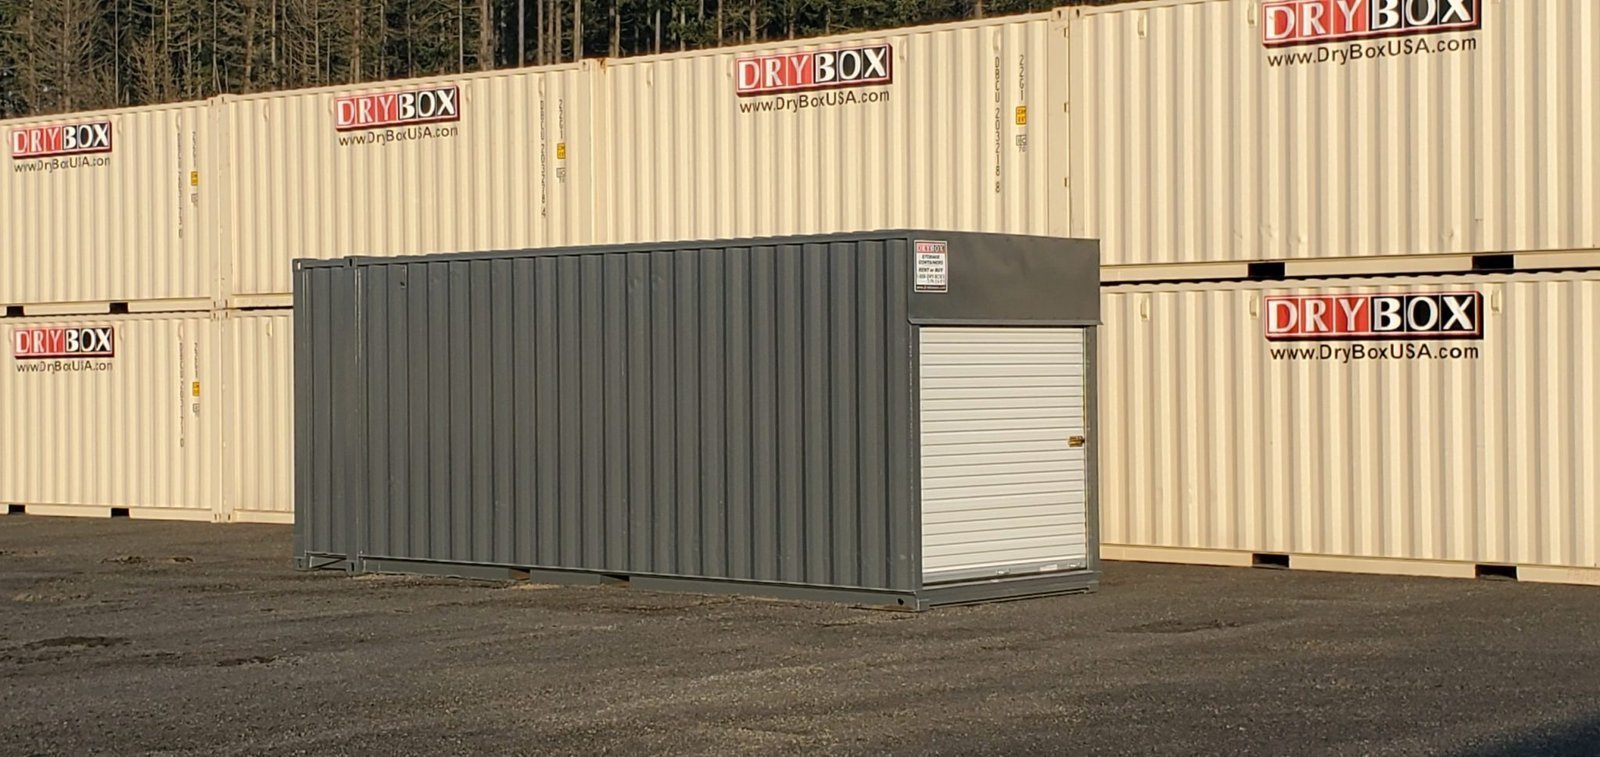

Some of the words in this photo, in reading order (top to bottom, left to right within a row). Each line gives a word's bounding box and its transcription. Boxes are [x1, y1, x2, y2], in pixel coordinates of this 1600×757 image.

[1267, 37, 1477, 67] www.DryBoxUSA.com
[738, 47, 886, 89] DRYBOX
[337, 89, 455, 125] DRYBOX
[740, 90, 890, 113] www.DryBoxUSA.com
[13, 124, 109, 153] DRYBOX
[1267, 294, 1474, 334] DRYBOX
[16, 328, 112, 354] DRYBOX
[1269, 343, 1479, 364] www.DryBoxUSA.com
